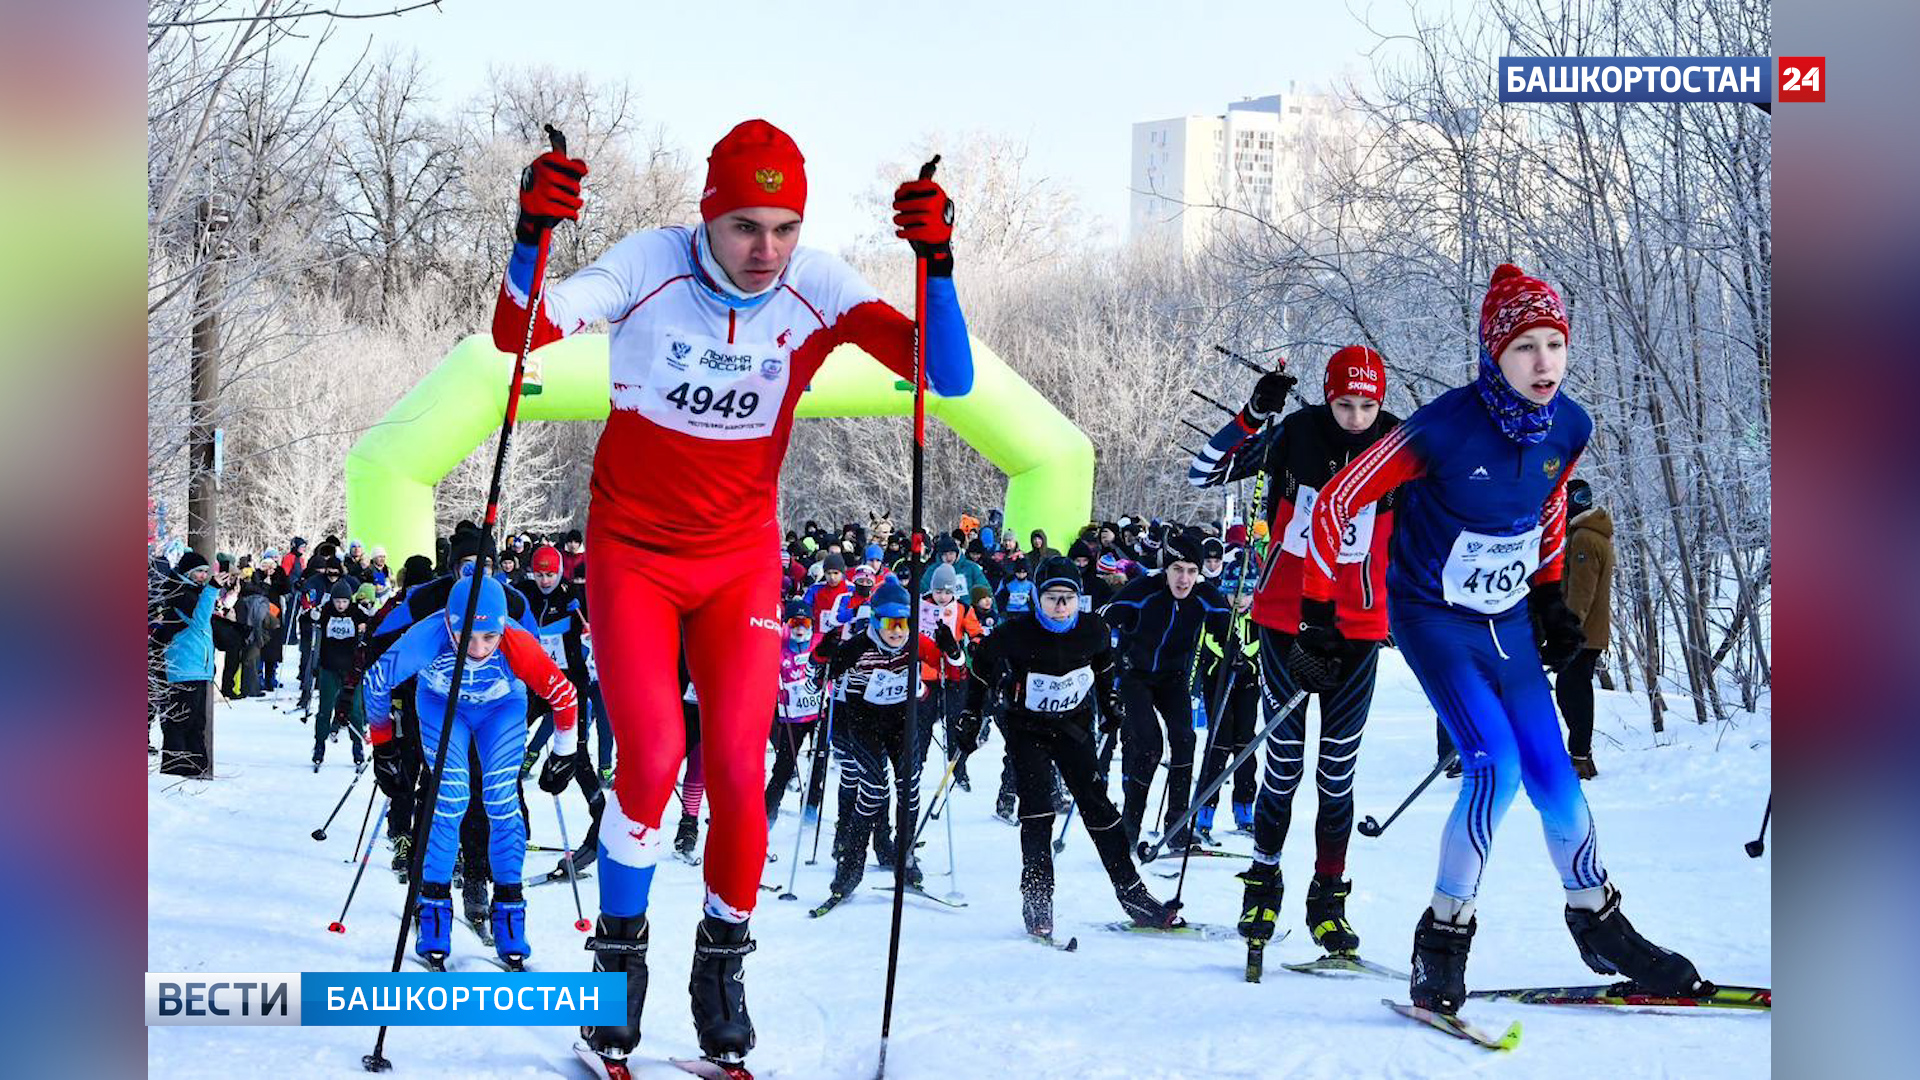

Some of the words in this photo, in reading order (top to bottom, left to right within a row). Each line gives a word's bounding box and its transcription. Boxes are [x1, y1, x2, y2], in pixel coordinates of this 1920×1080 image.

[704, 349, 752, 363] ЛЫЖНЯ
[699, 357, 752, 371] РОССИИ
[1347, 366, 1378, 381] DNB
[666, 382, 760, 419] 4949
[1037, 691, 1080, 713] 4044
